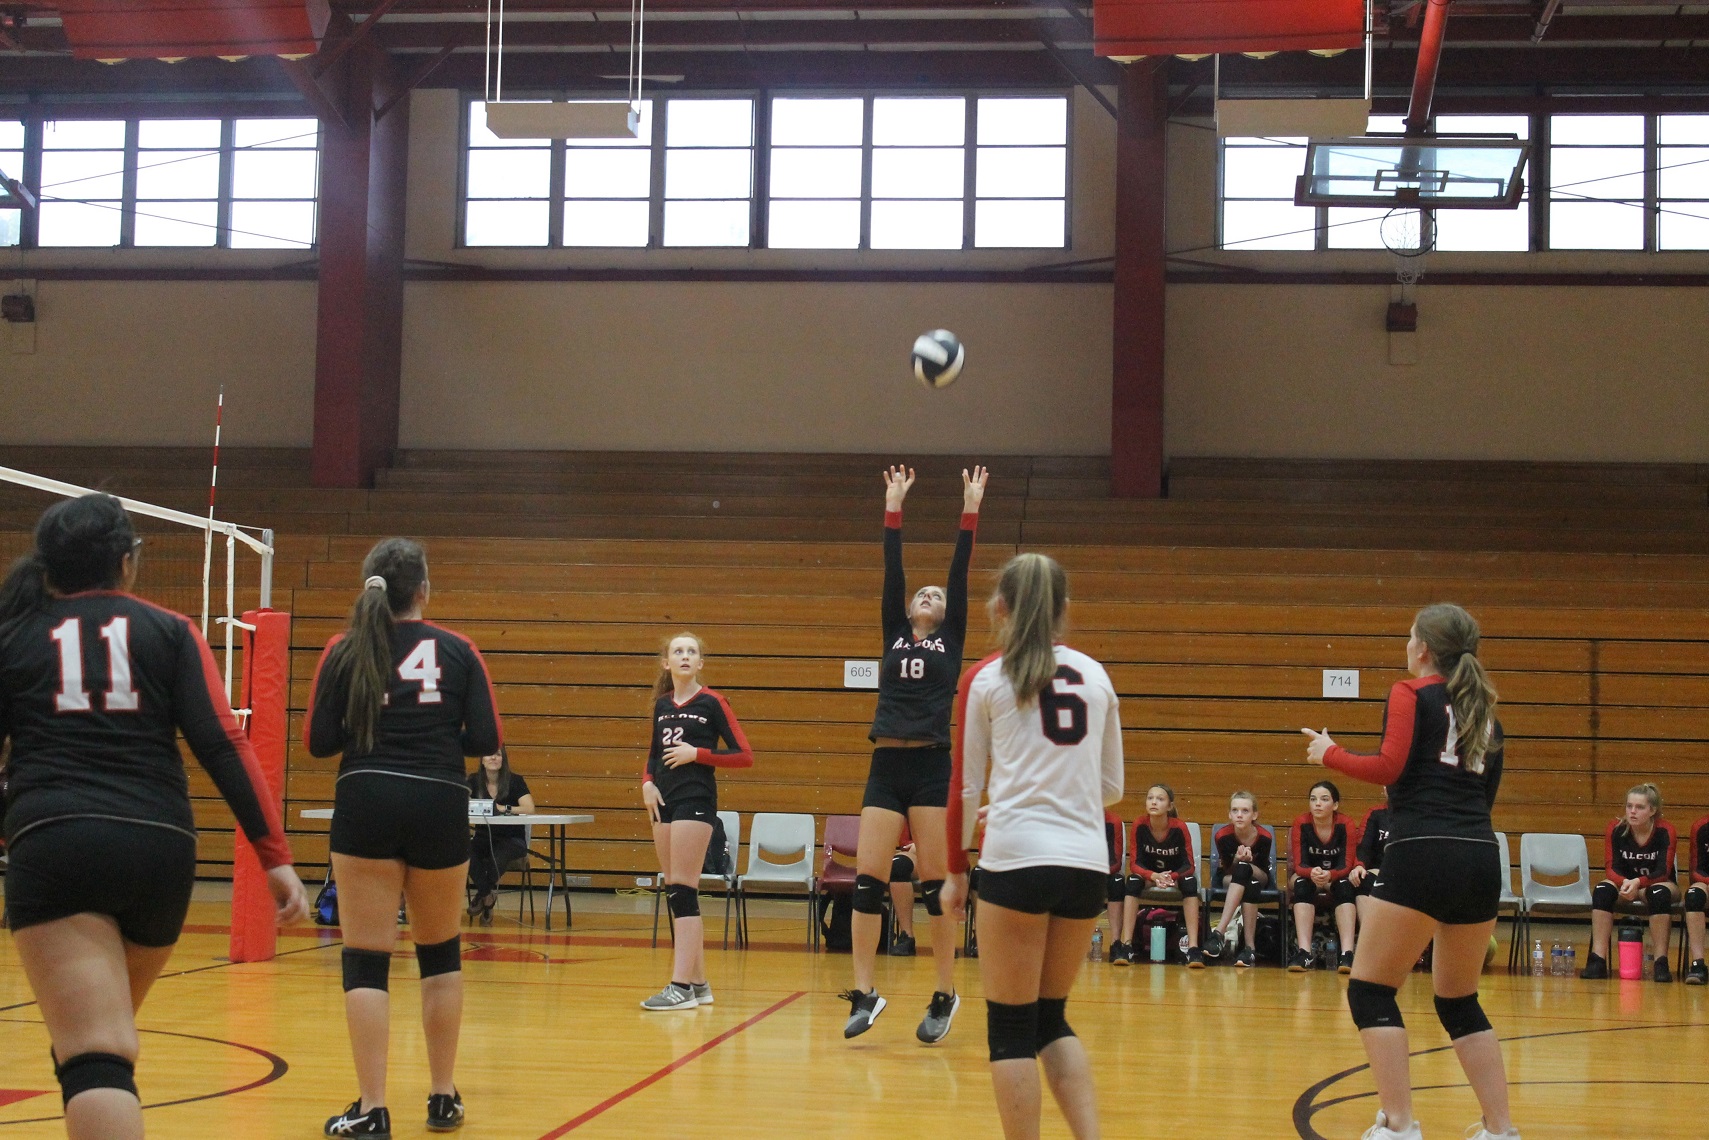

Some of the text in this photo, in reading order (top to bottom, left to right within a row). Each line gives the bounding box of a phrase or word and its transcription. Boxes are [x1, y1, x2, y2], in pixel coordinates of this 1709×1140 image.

[49, 616, 140, 713] 11
[380, 638, 443, 705] 4
[850, 666, 872, 678] 605
[900, 657, 925, 679] 18
[1329, 675, 1352, 687] 714
[1038, 664, 1089, 746] 6
[662, 727, 685, 746] 22
